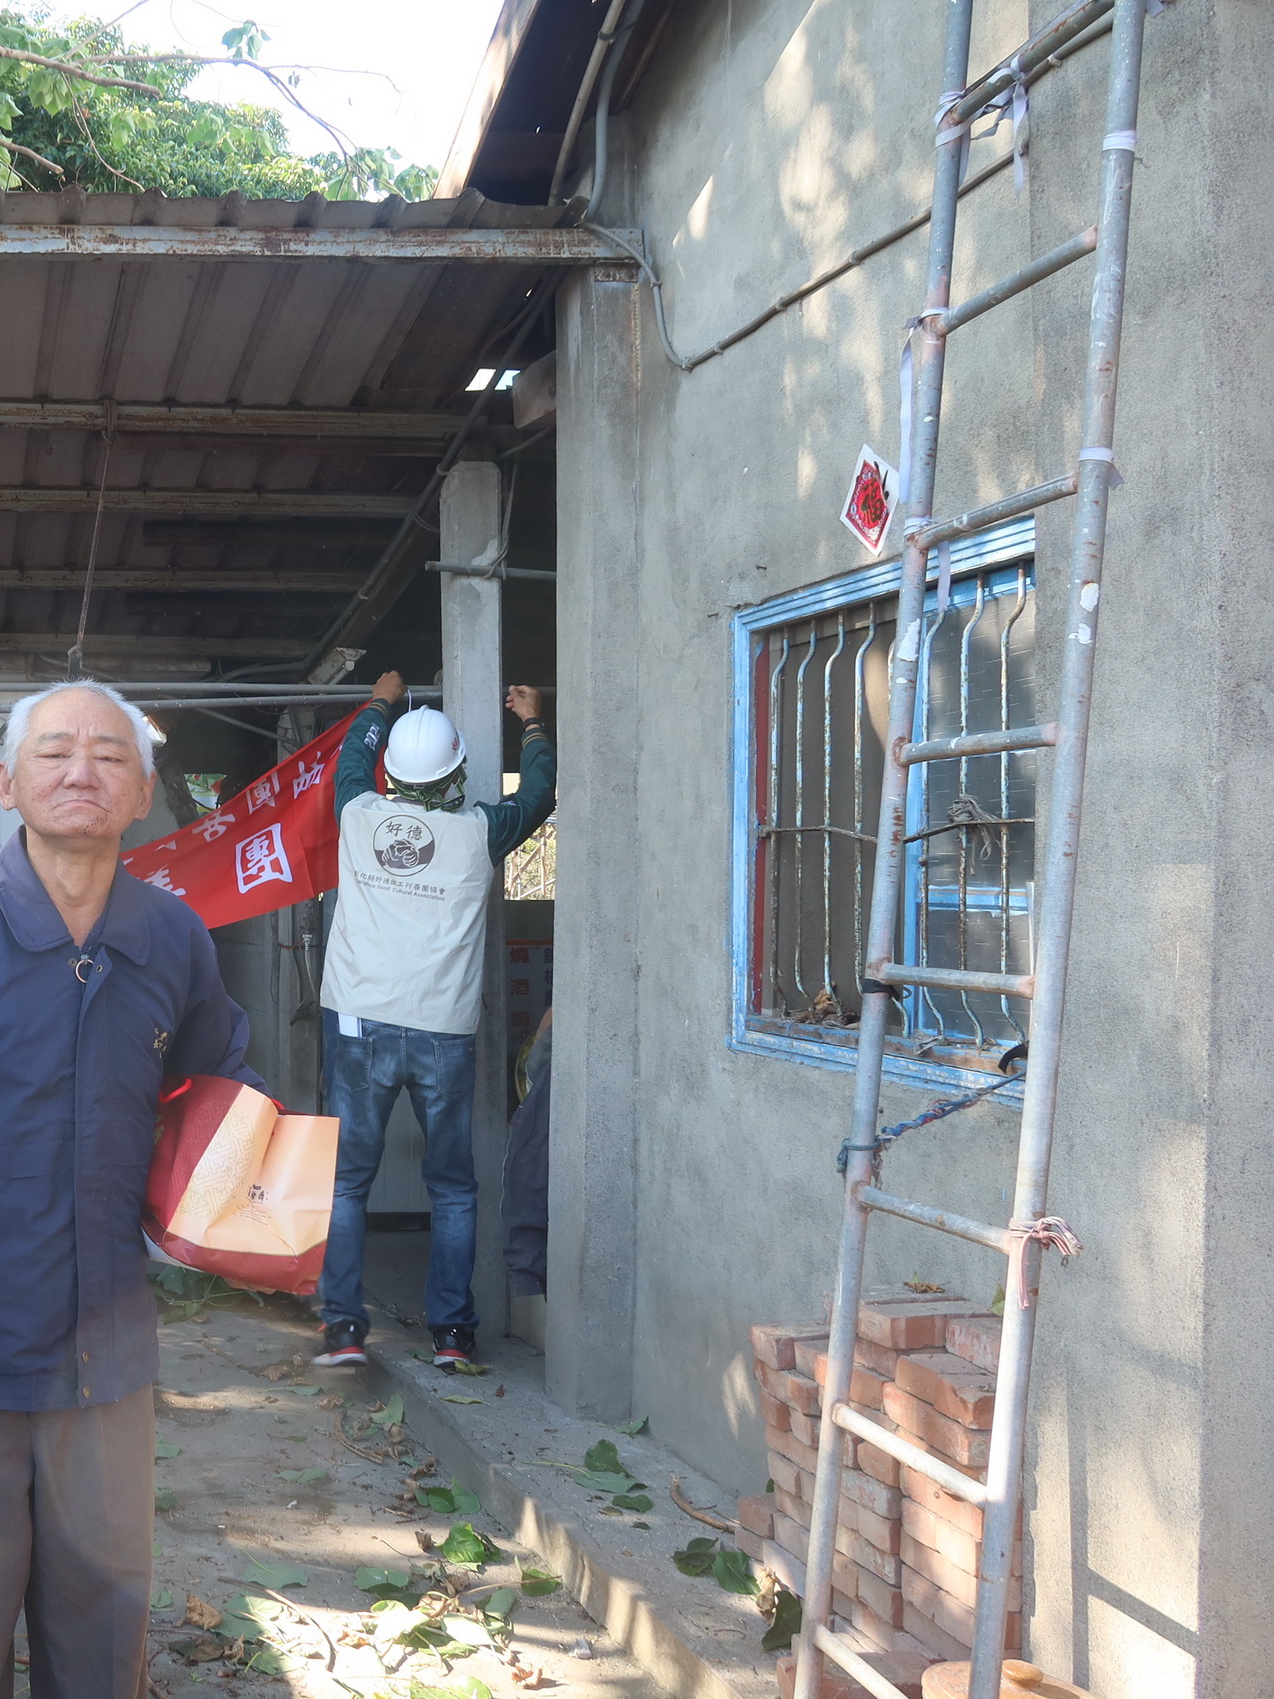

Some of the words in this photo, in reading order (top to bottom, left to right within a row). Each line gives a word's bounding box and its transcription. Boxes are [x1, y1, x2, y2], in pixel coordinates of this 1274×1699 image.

[385, 821, 423, 840] 好德
[392, 887, 413, 896] Cultural
[413, 891, 446, 901] Association
